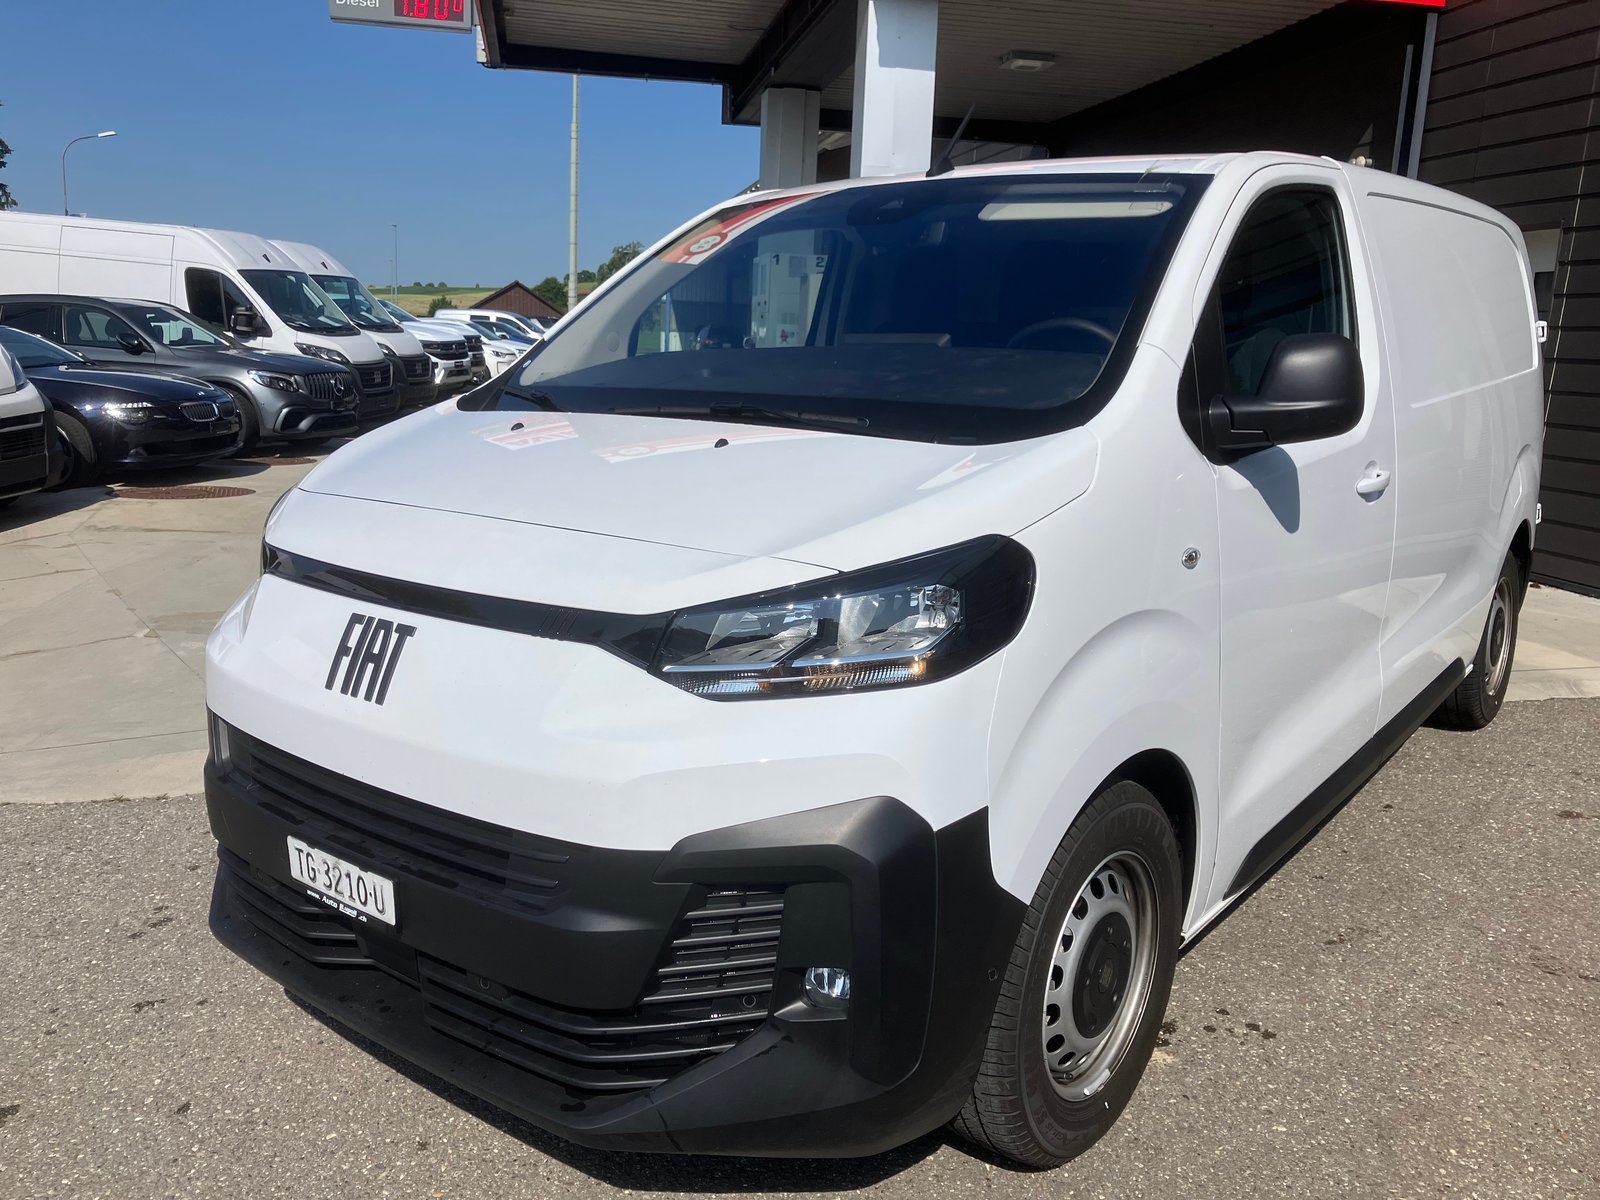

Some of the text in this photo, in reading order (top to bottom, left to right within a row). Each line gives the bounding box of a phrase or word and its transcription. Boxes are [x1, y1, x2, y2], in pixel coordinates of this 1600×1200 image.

[773, 254, 780, 265] 1
[815, 256, 825, 268] 2
[324, 612, 418, 706] FIAT
[322, 896, 337, 908] Auto
